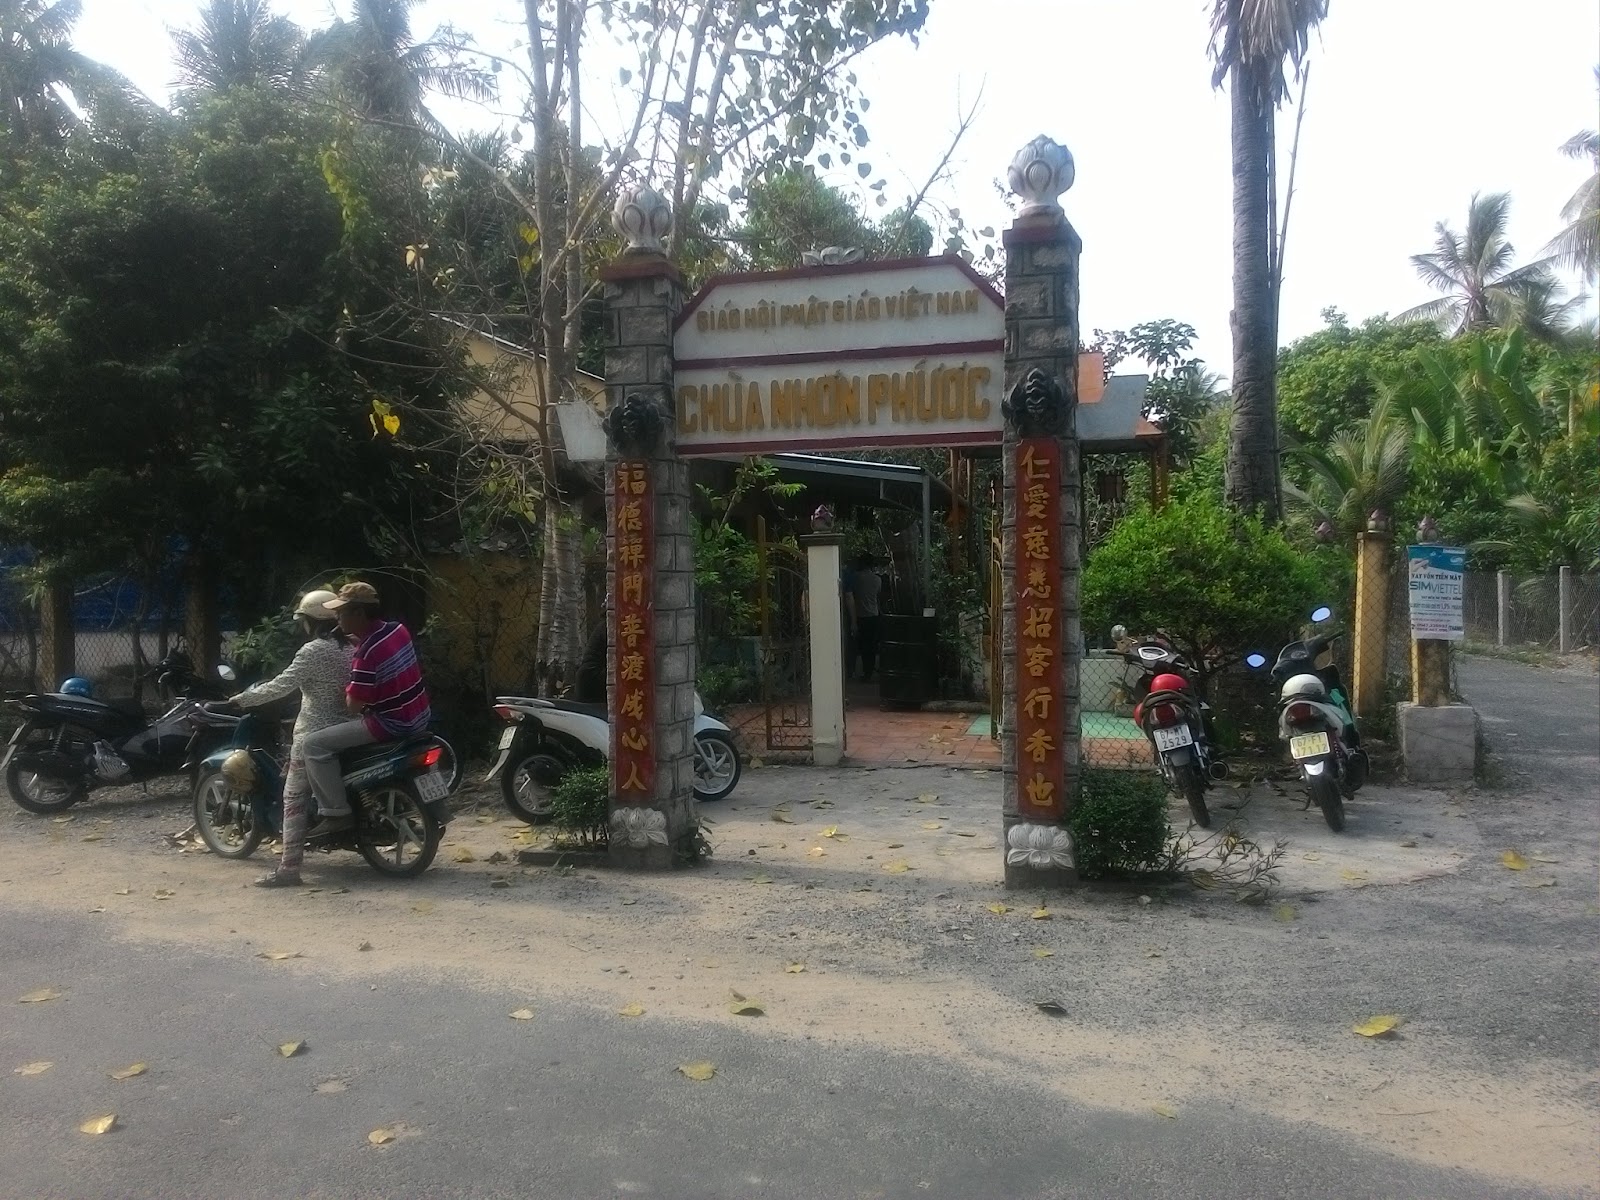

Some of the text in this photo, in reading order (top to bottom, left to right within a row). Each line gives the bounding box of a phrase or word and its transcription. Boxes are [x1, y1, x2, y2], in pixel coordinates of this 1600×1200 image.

[936, 289, 979, 315] NAM
[676, 357, 991, 433] CHÙA NHƠN PHƯỚC
[1162, 735, 1188, 750] 2529
